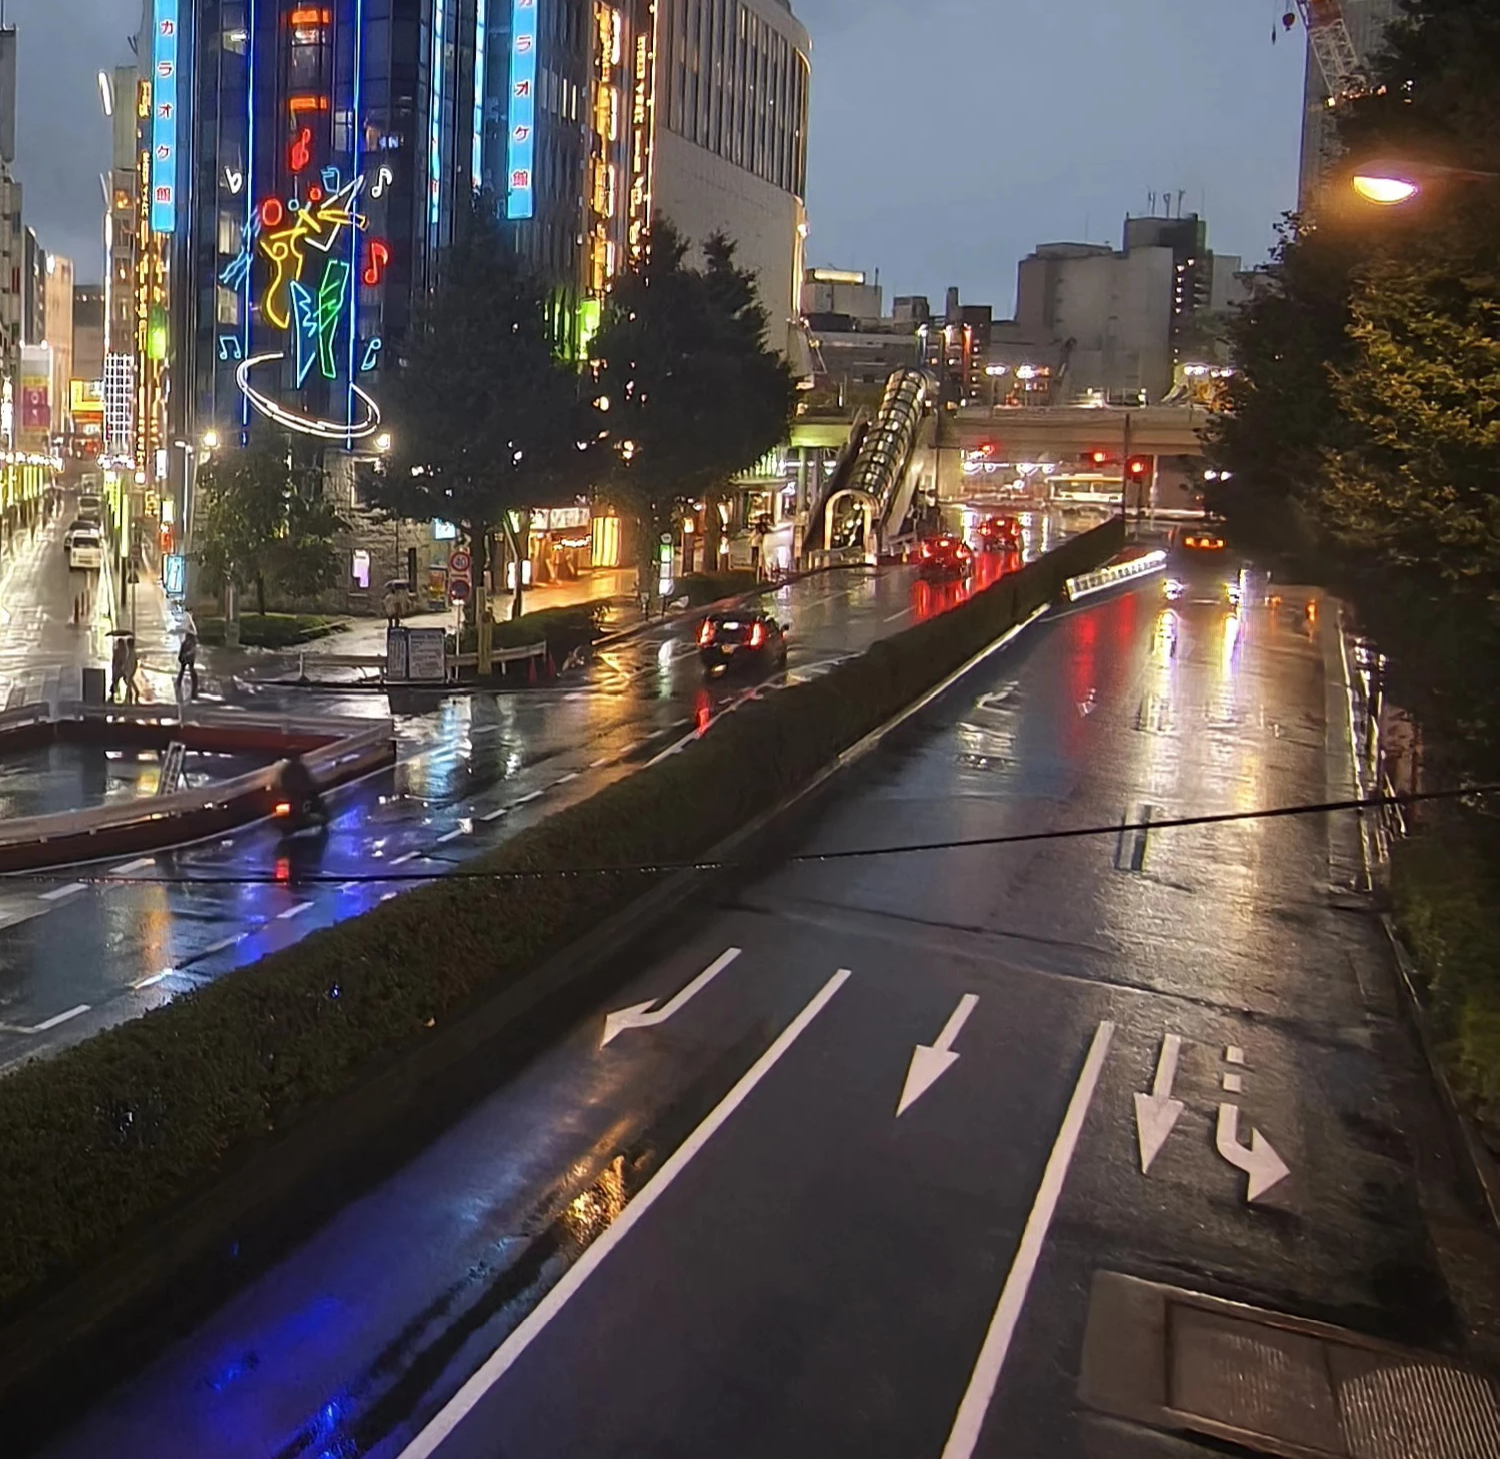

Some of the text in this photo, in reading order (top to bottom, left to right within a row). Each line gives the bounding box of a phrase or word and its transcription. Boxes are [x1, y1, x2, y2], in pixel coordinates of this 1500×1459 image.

[156, 19, 176, 202] カラオケ館
